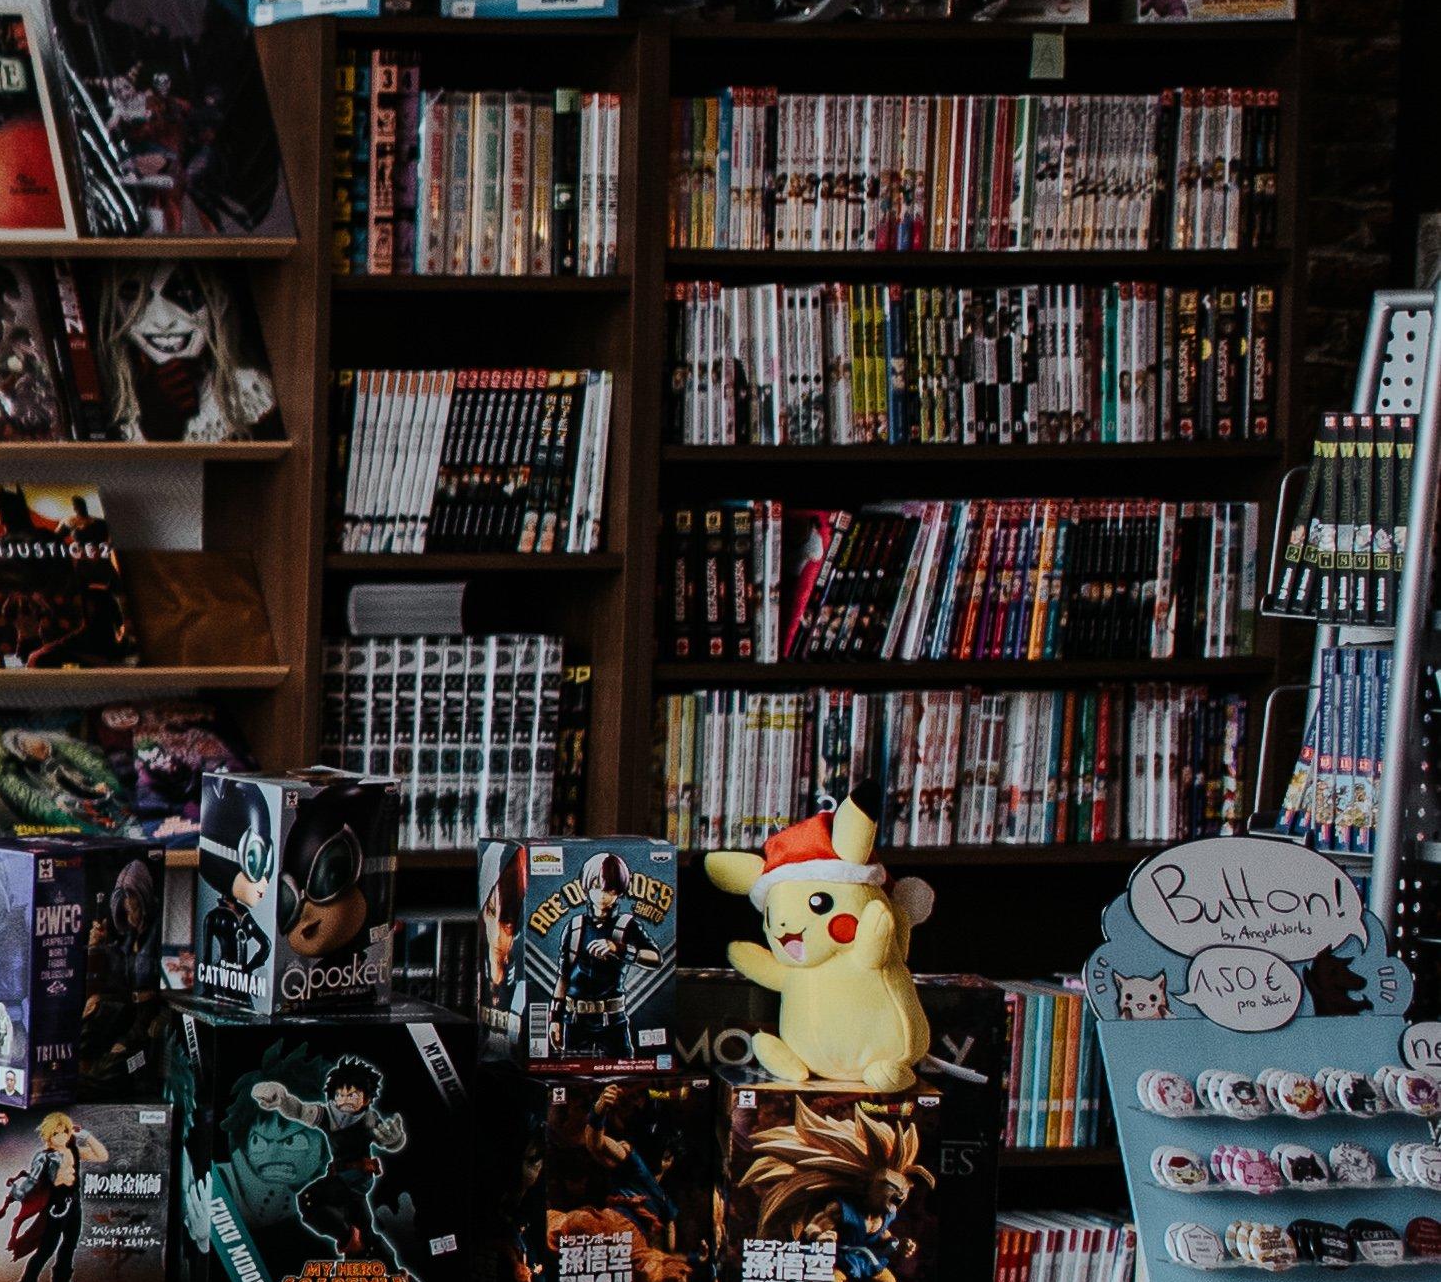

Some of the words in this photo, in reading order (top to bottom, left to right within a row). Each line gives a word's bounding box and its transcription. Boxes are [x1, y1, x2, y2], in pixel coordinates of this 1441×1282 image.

[99, 541, 111, 559] 2
[1150, 863, 1346, 925] Button!
[36, 905, 82, 937] BWFC
[197, 964, 267, 997] CATWOMAN
[1193, 963, 1256, 997] 1,50
[1262, 963, 1283, 993] €
[1237, 997, 1259, 1015] pro
[211, 1196, 243, 1245] IZUKU
[303, 1260, 335, 1277] MY
[337, 1260, 386, 1277] HERO
